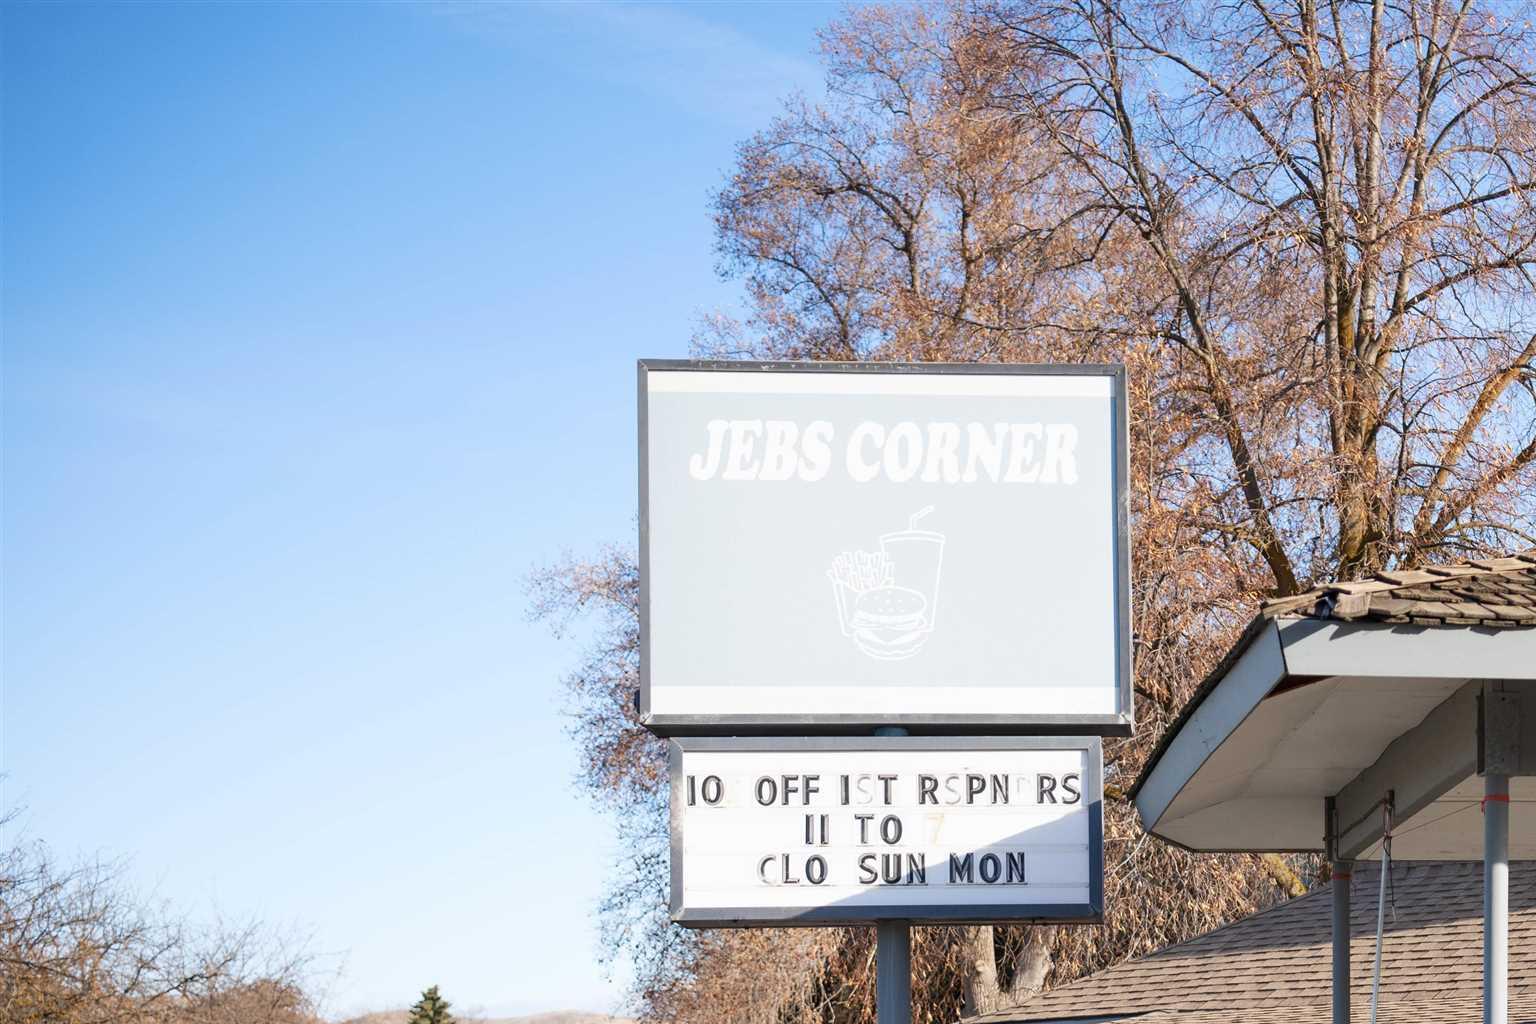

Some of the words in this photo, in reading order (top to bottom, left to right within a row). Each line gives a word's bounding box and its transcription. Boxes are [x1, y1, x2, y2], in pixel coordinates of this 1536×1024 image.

[689, 419, 835, 482] JEBS
[845, 421, 1080, 486] CORNER
[755, 774, 820, 806] OFF
[854, 814, 903, 845] TO
[757, 853, 828, 885] CLO
[858, 853, 927, 885] SUN
[949, 852, 1026, 884] MON
